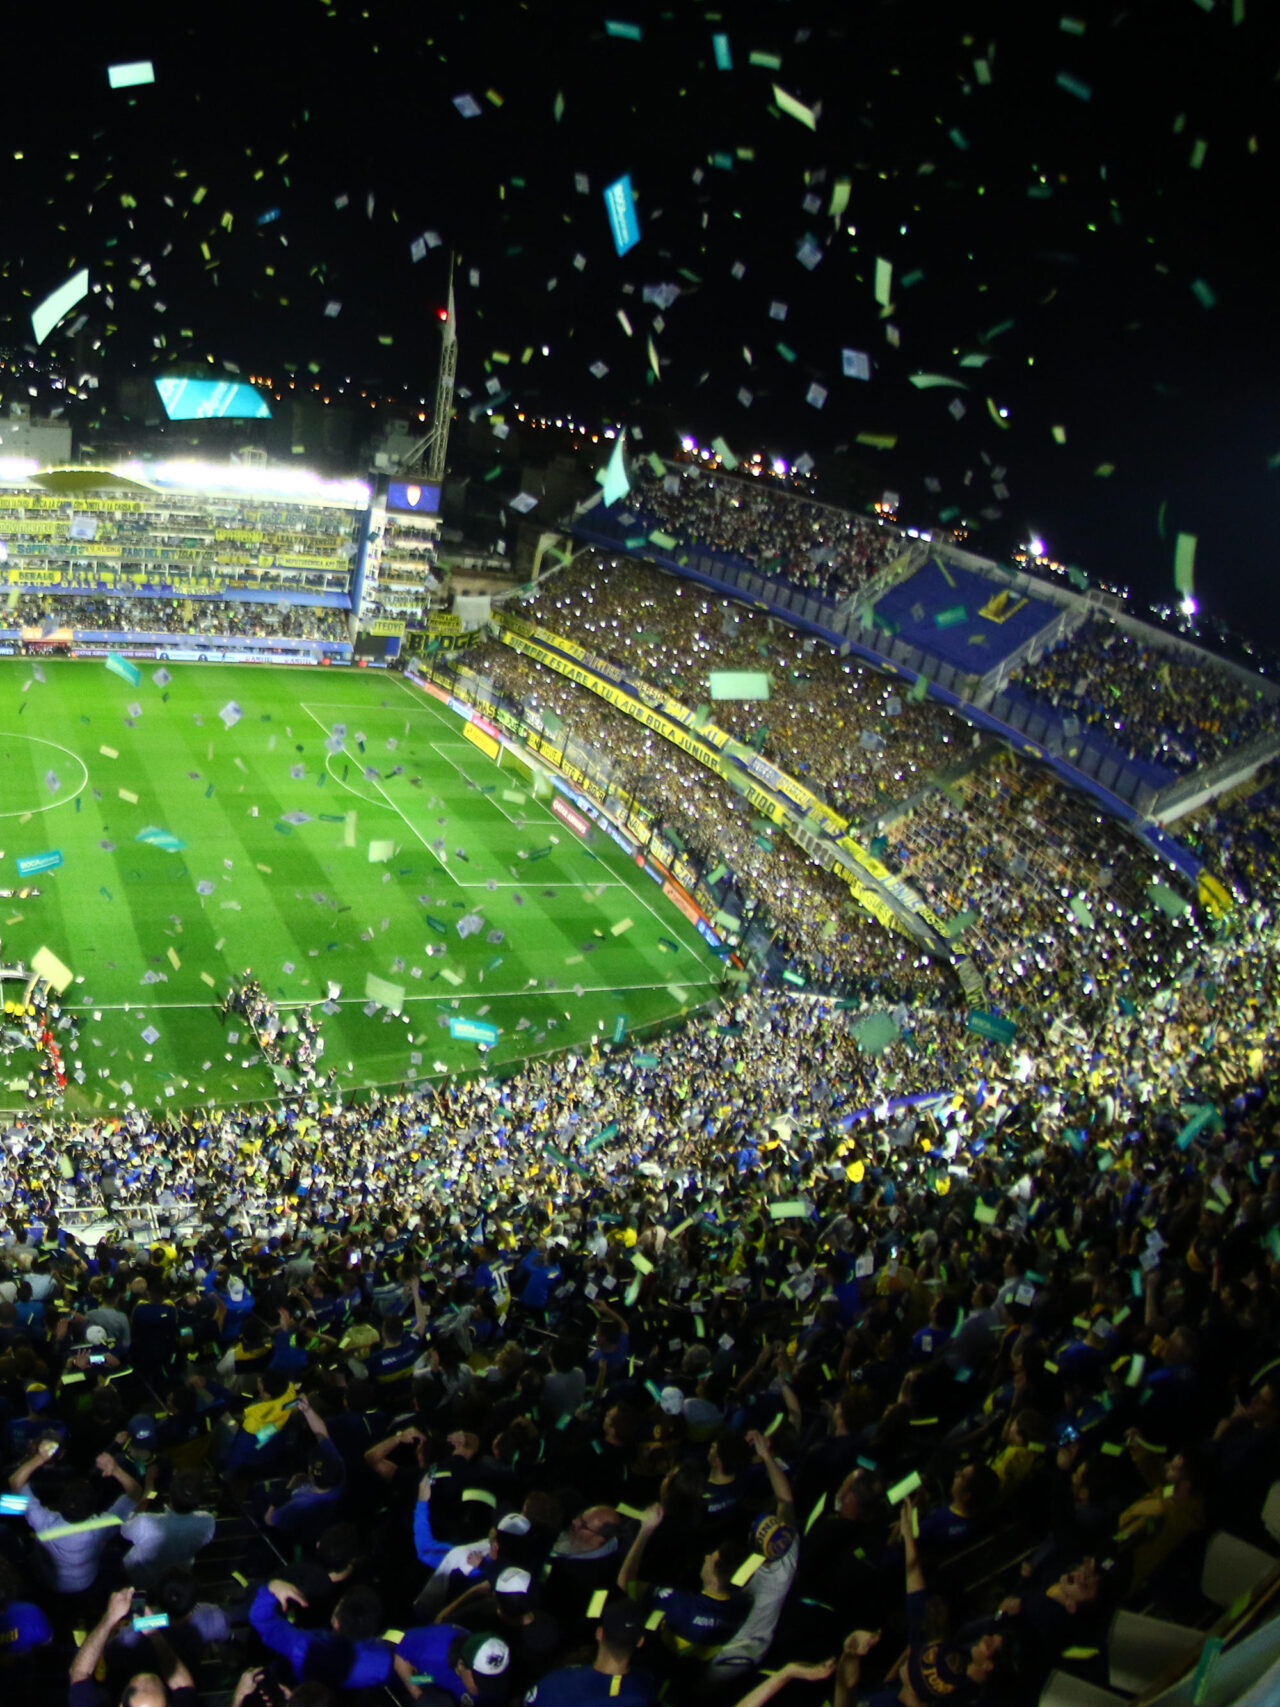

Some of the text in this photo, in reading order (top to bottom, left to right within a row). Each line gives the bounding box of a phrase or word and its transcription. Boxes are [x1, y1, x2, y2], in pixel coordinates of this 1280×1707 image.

[508, 635, 548, 664] SIEMPRE
[550, 657, 589, 686] ESTARE
[591, 681, 599, 694] A
[601, 683, 614, 699] TU
[646, 711, 677, 742] BOCA
[679, 737, 720, 770] JUNIOR
